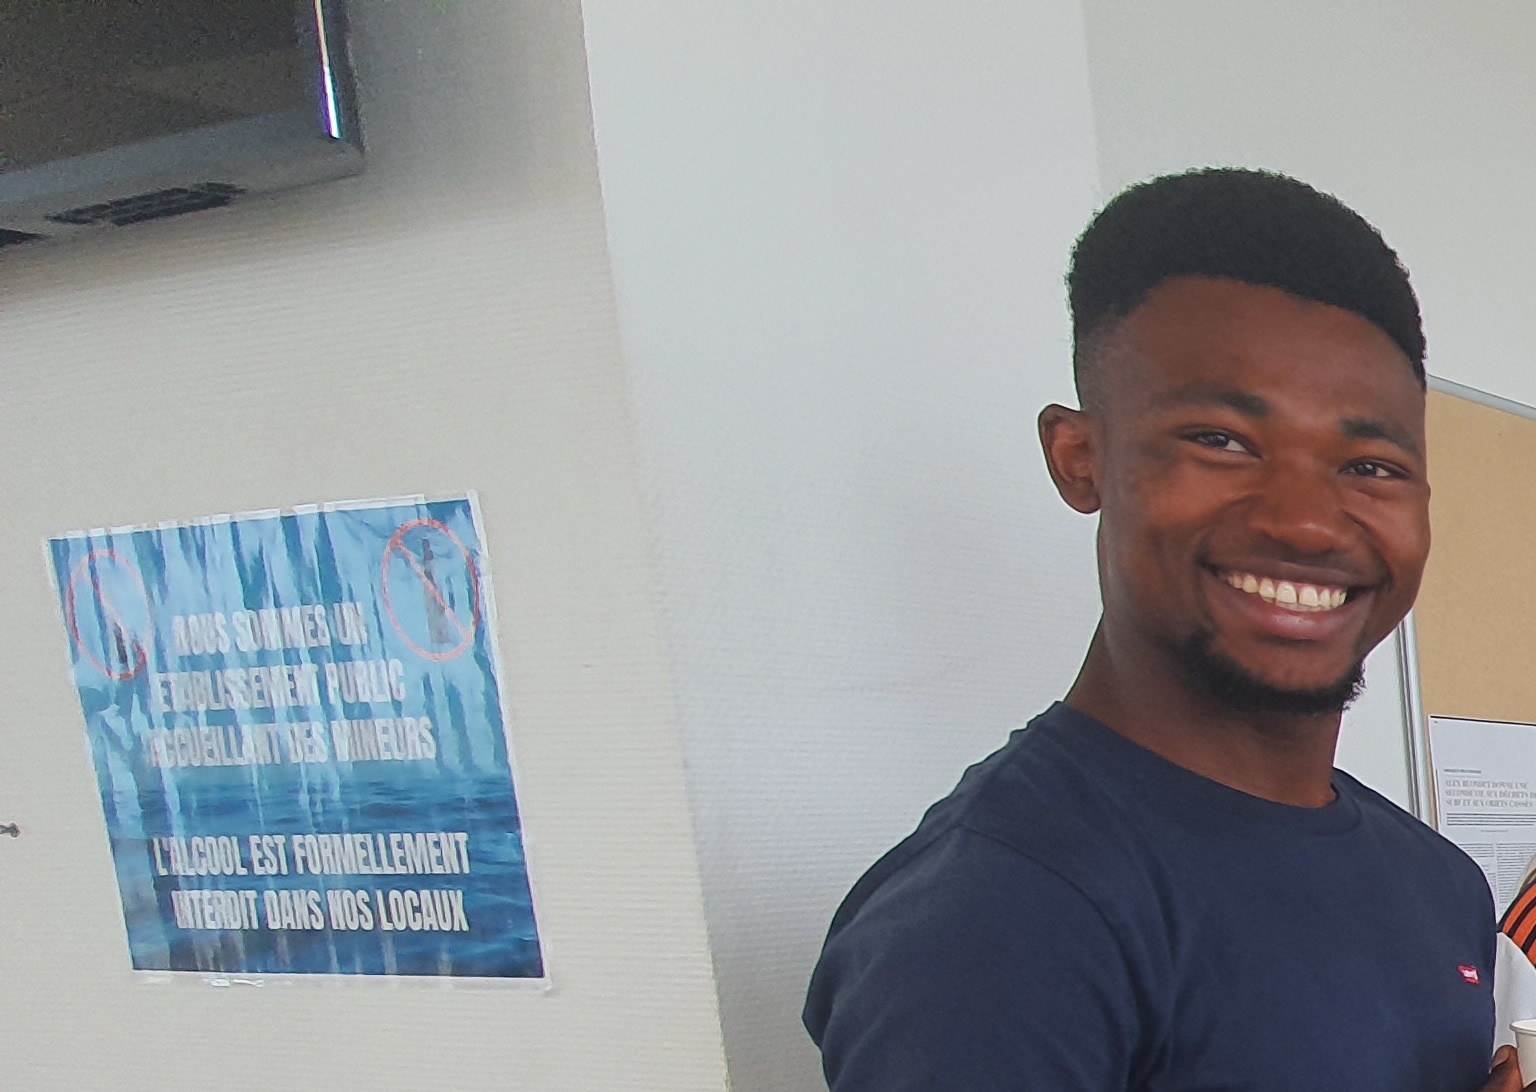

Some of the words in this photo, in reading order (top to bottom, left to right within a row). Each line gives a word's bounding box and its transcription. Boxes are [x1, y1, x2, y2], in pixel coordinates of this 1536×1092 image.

[173, 613, 231, 656] NOUS
[232, 604, 331, 652] SOMMES
[325, 658, 406, 704] PUBLIC
[287, 721, 328, 764] DES
[330, 716, 437, 762] MINEURS
[153, 835, 248, 876] L'ALCOOL
[249, 835, 289, 876] EST
[291, 832, 470, 875] FORMELLEMENT
[171, 889, 259, 930] INTERDIT
[263, 889, 325, 931] DANS
[326, 889, 374, 931] NOS
[375, 889, 470, 931] LOCAUX
